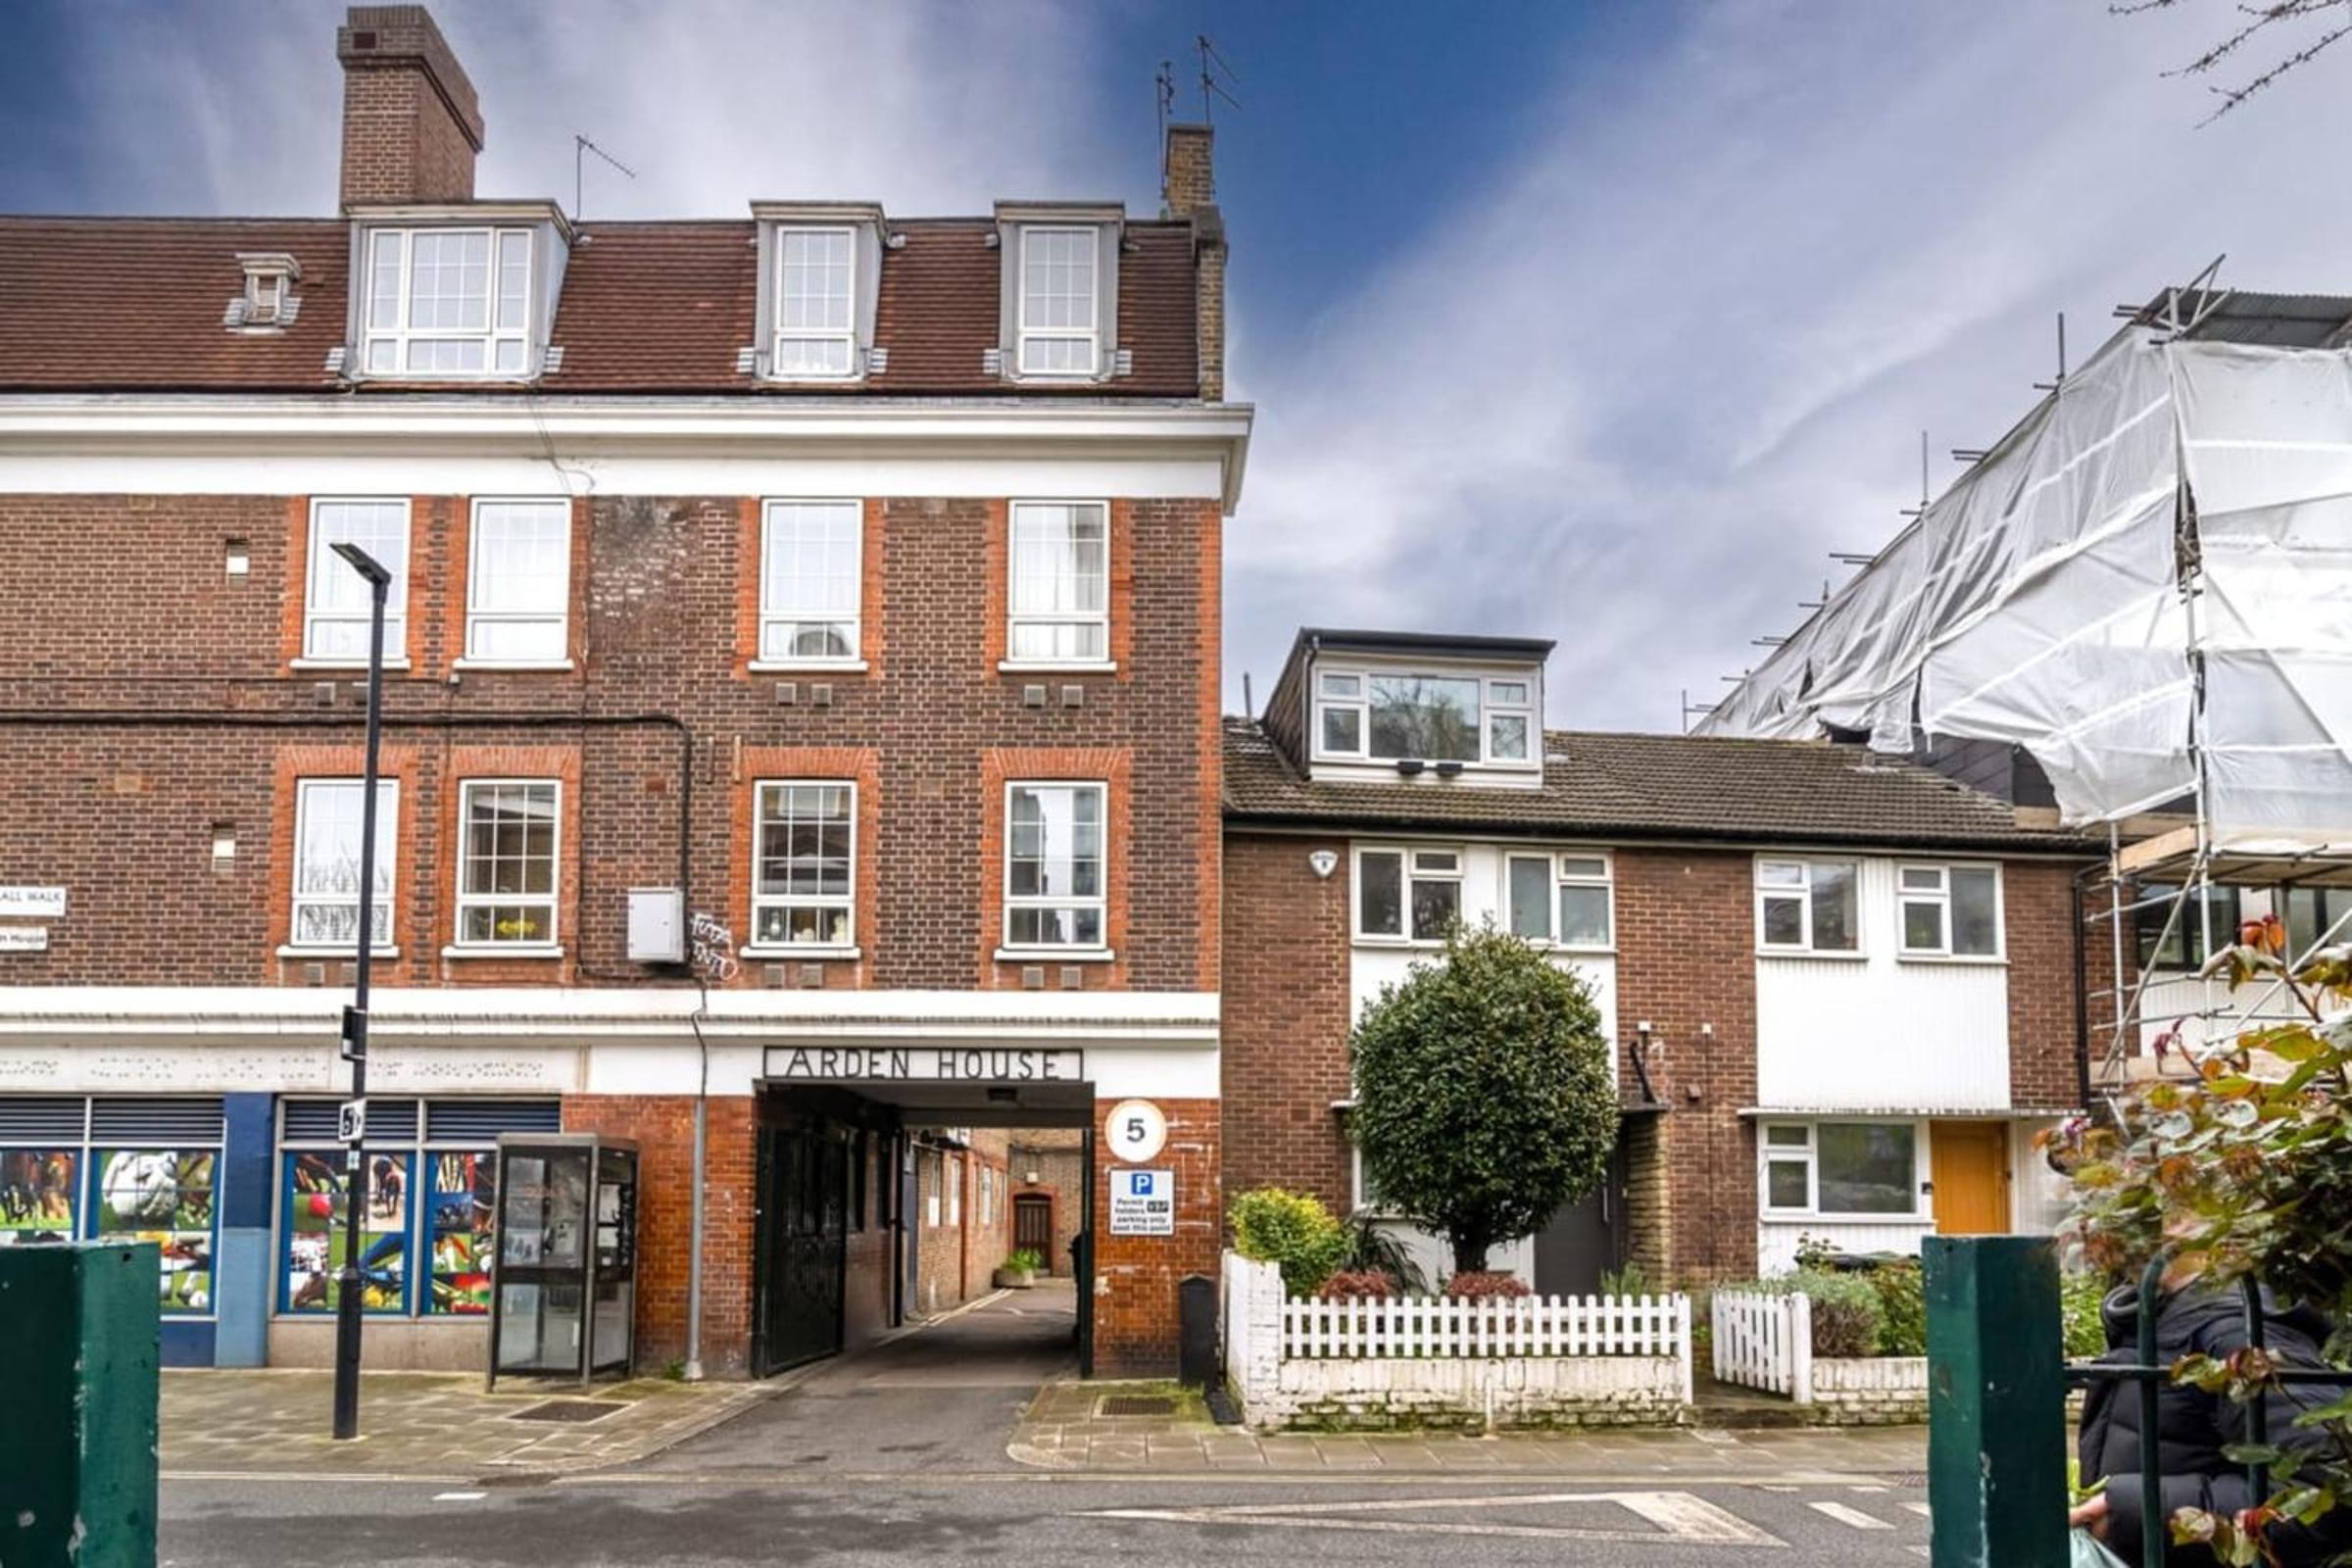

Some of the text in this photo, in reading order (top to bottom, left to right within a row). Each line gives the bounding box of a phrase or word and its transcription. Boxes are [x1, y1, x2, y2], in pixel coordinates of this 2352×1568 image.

[26, 890, 62, 903] WALK
[786, 1049, 1060, 1079] ARDEN HOUSE
[1126, 1118, 1146, 1143] 5
[1137, 1176, 1151, 1193] P
[1116, 1215, 1167, 1225] parking only
[1113, 1224, 1130, 1233] past
[1150, 1224, 1170, 1233] point
